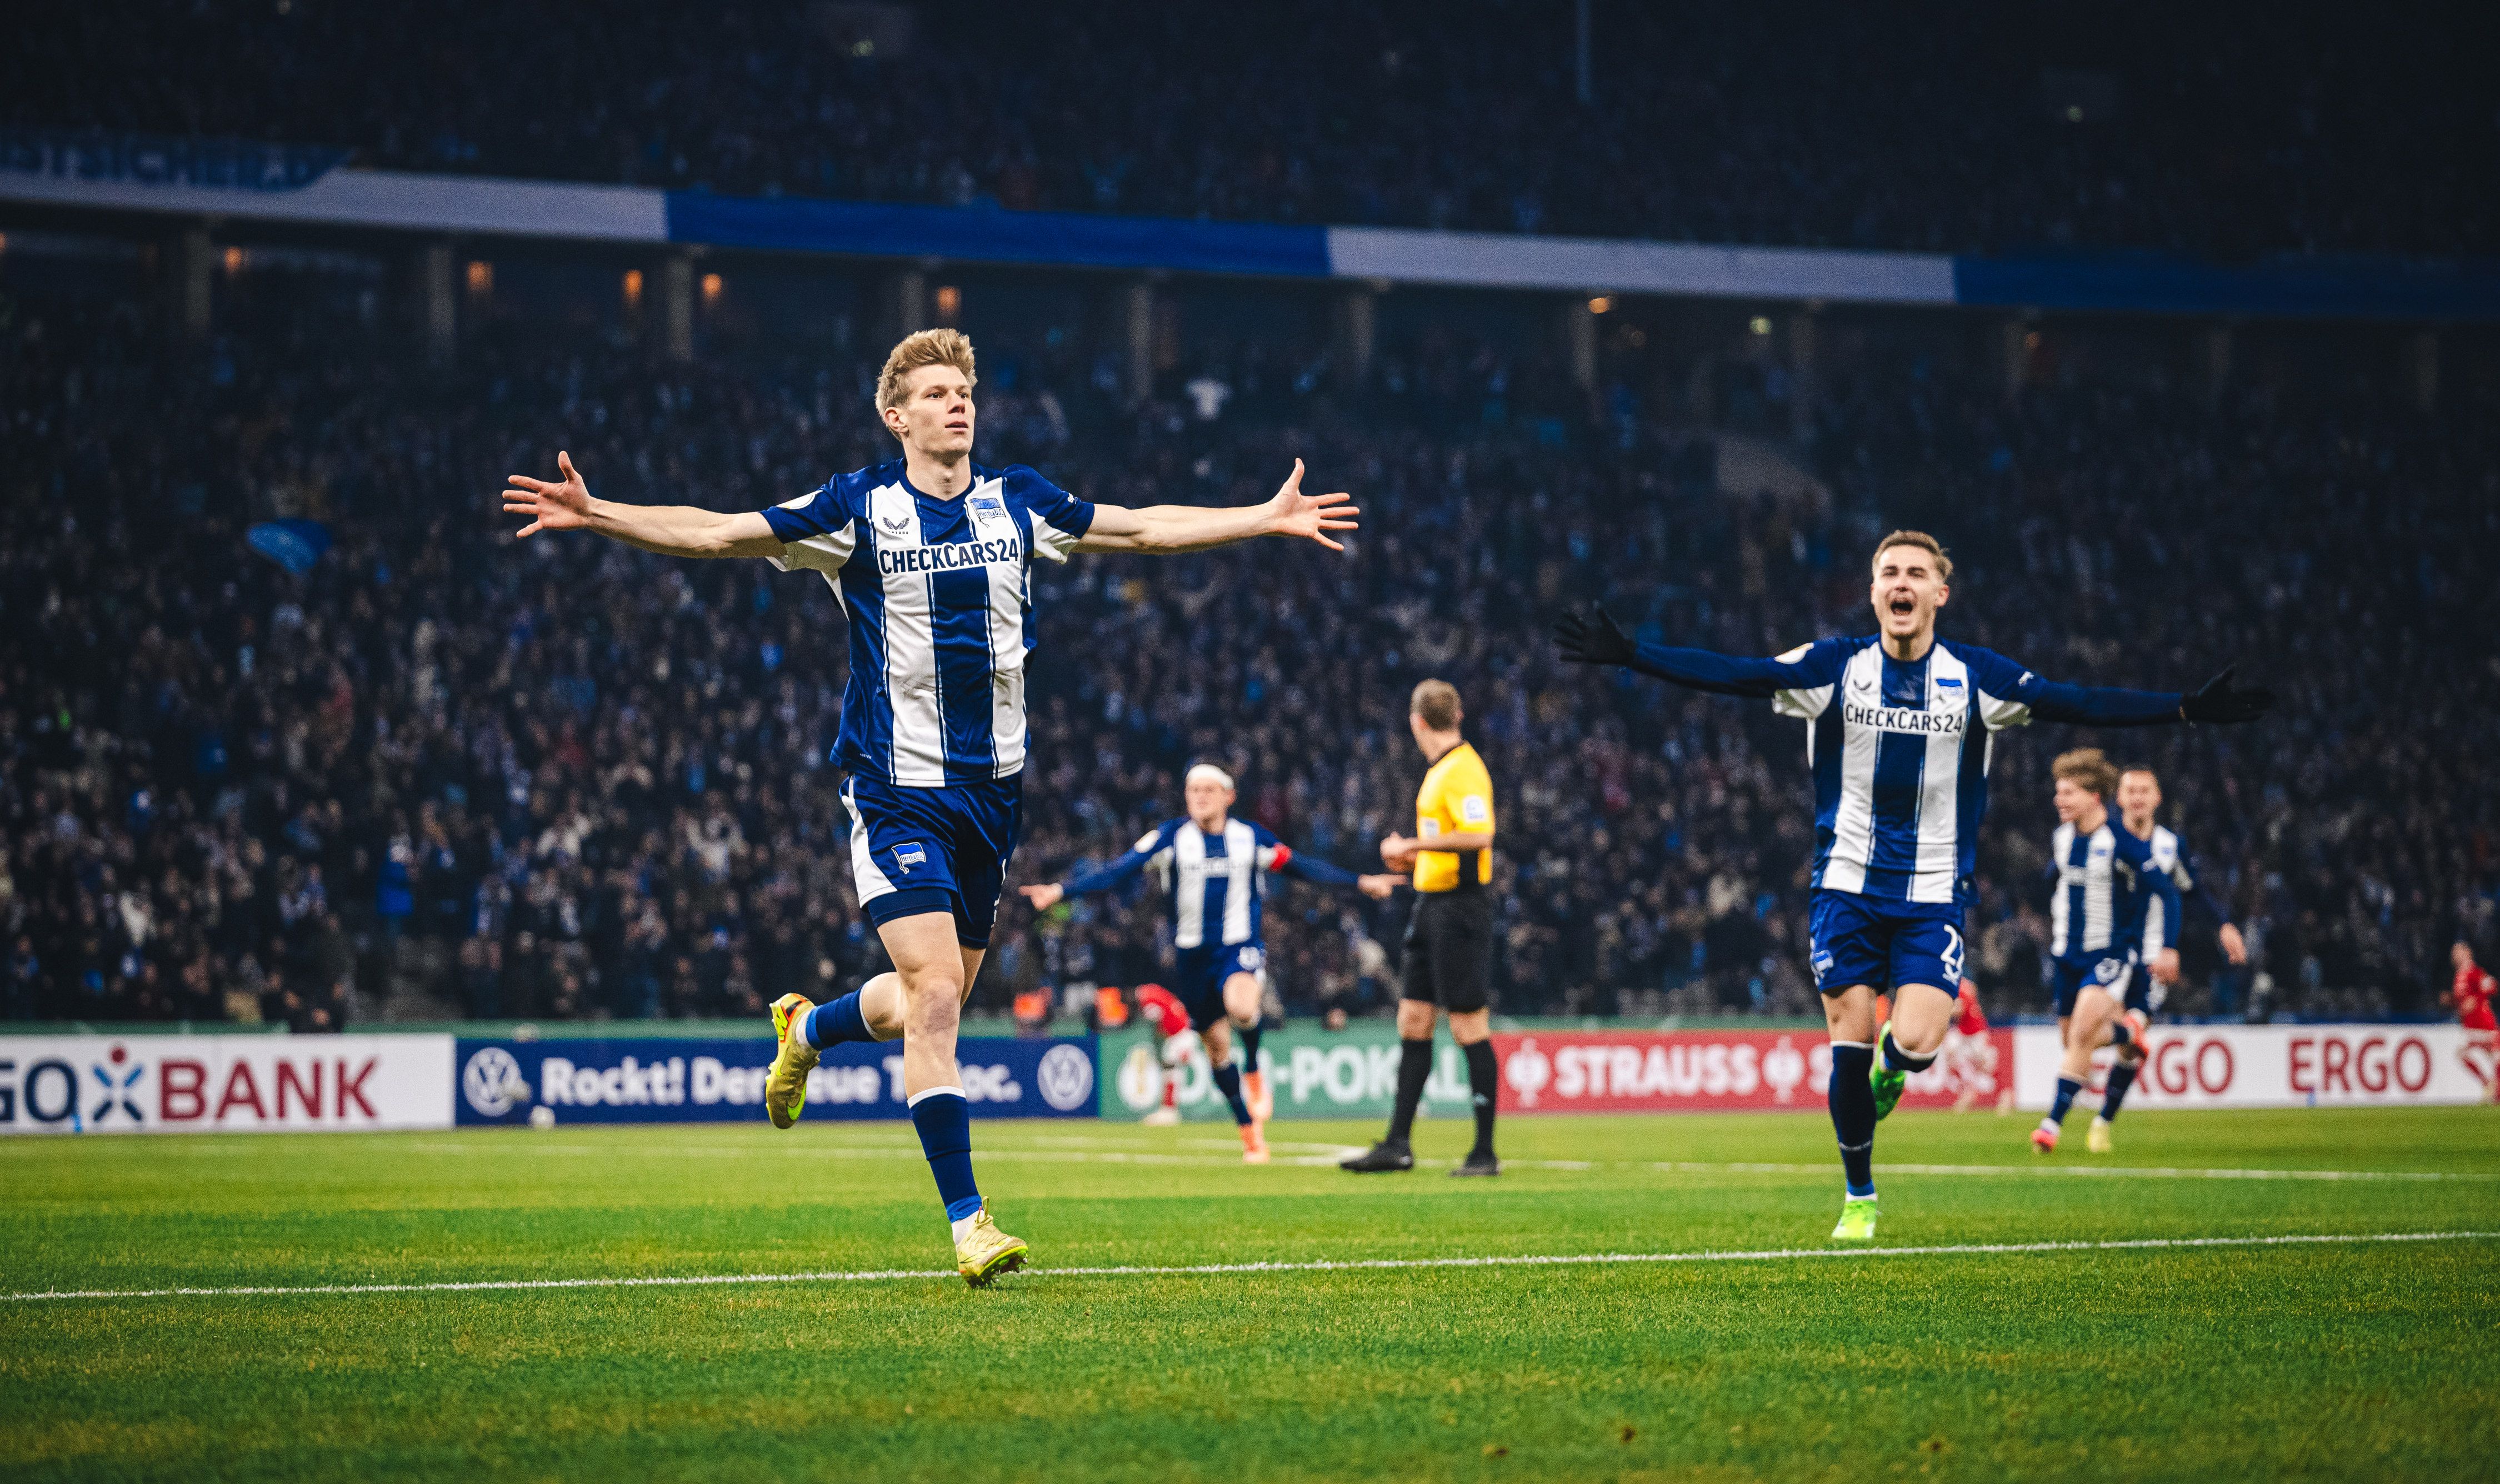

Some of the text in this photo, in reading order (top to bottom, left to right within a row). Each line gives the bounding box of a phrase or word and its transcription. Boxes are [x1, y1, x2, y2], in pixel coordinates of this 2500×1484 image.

[879, 538, 1018, 574] CHECKCARS24
[1846, 703, 1963, 733] CHECKCARS24
[159, 1058, 379, 1121] BANK
[541, 1055, 686, 1106] Rockt!
[691, 1055, 769, 1106] Der
[1555, 1043, 1761, 1097] STRAUSS
[2288, 1037, 2432, 1094] ERGO
